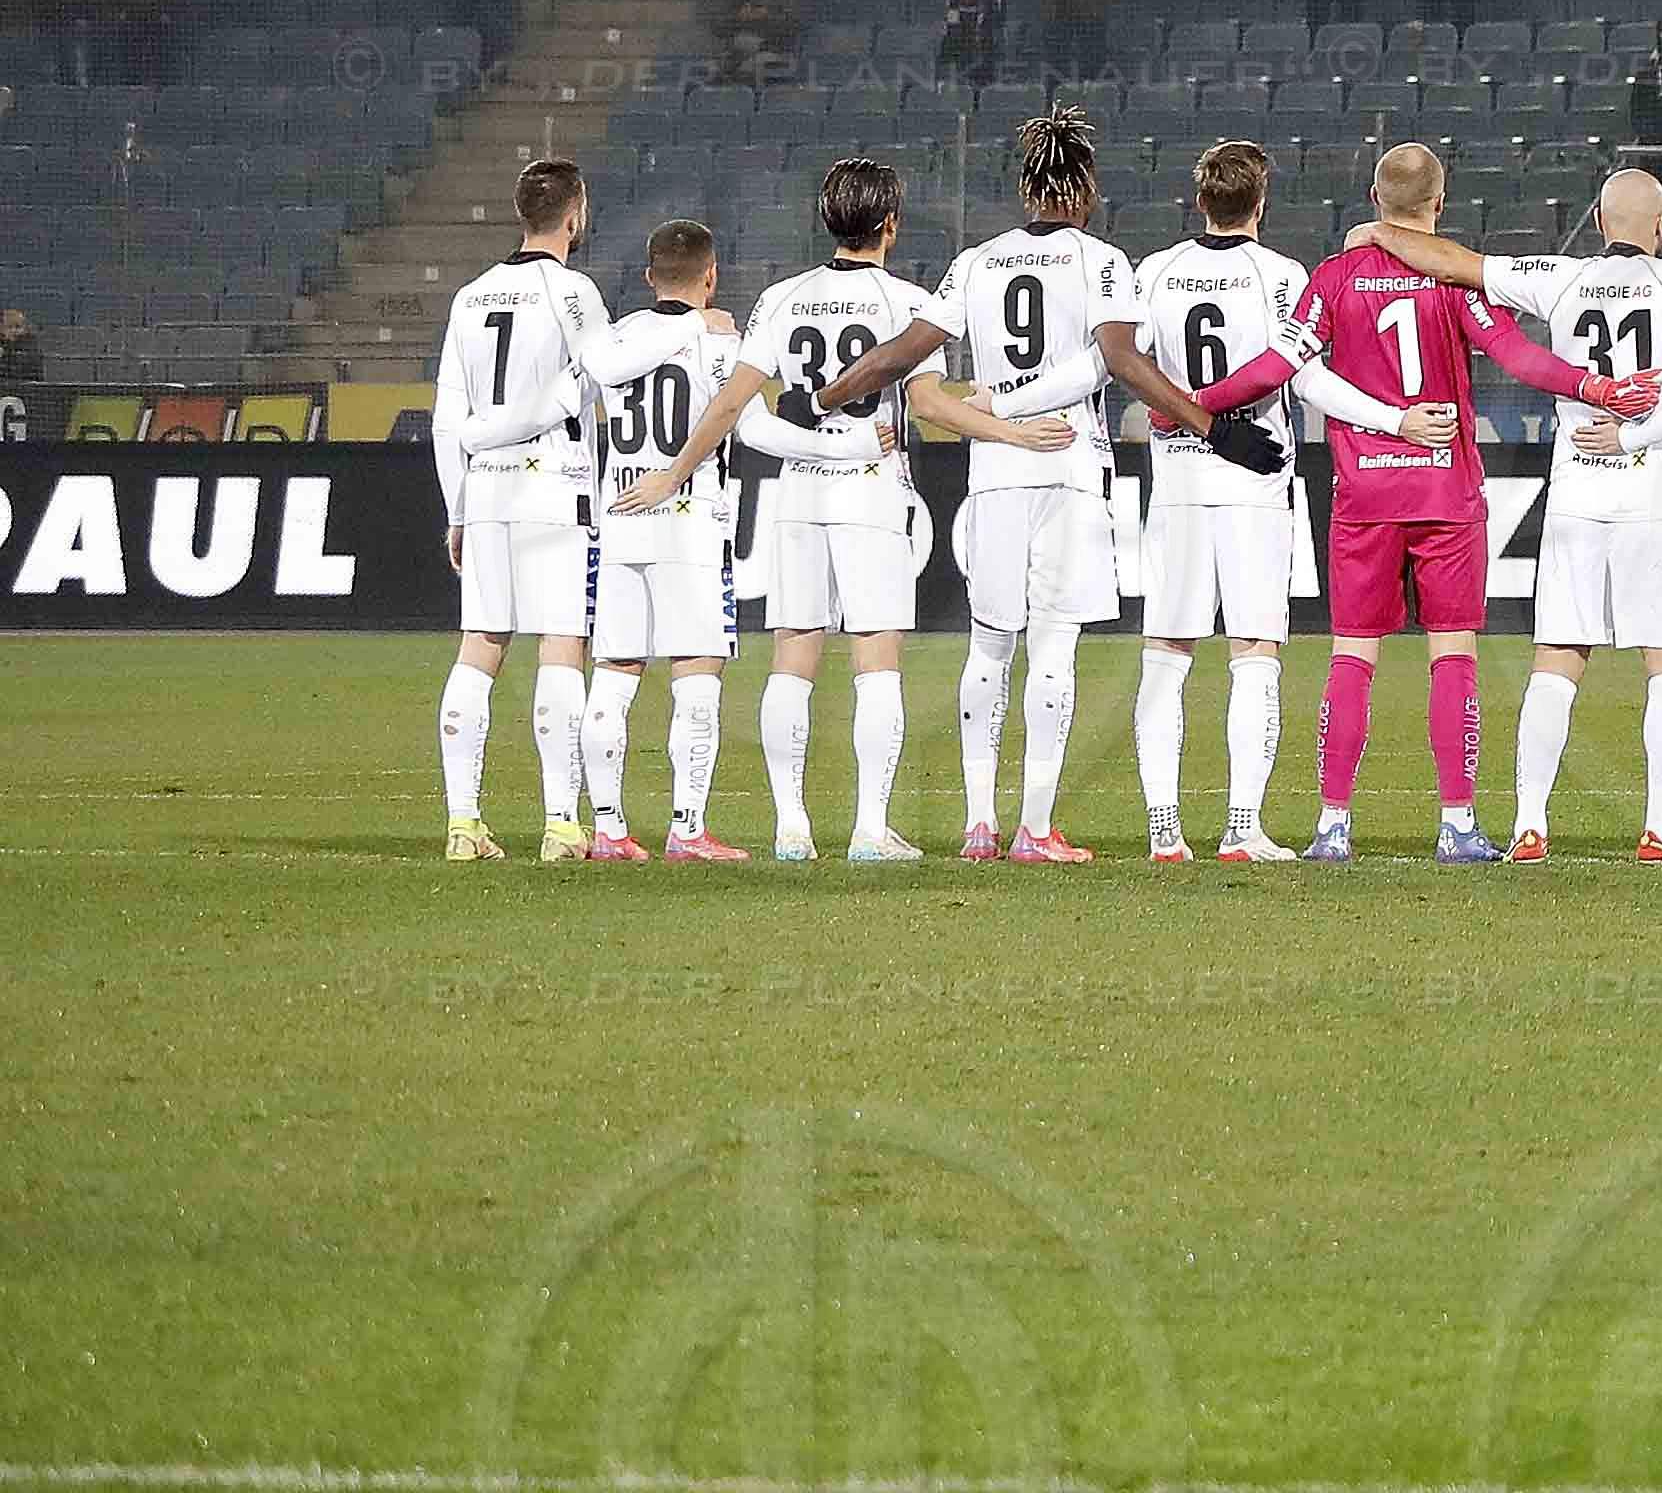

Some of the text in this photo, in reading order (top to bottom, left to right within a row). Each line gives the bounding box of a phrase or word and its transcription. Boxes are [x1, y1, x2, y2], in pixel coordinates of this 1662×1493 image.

[1511, 259, 1558, 275] Zipfer
[1003, 273, 1045, 370] 9
[1184, 302, 1228, 395] 6
[1375, 297, 1425, 398] 1
[1573, 308, 1653, 378] 31
[609, 363, 691, 458] 30
[788, 323, 879, 419] 38
[1357, 453, 1433, 470] Raiffeisen
[687, 707, 713, 796] MOLTO LUCE
[1464, 696, 1479, 782] MOLTO LUCE
